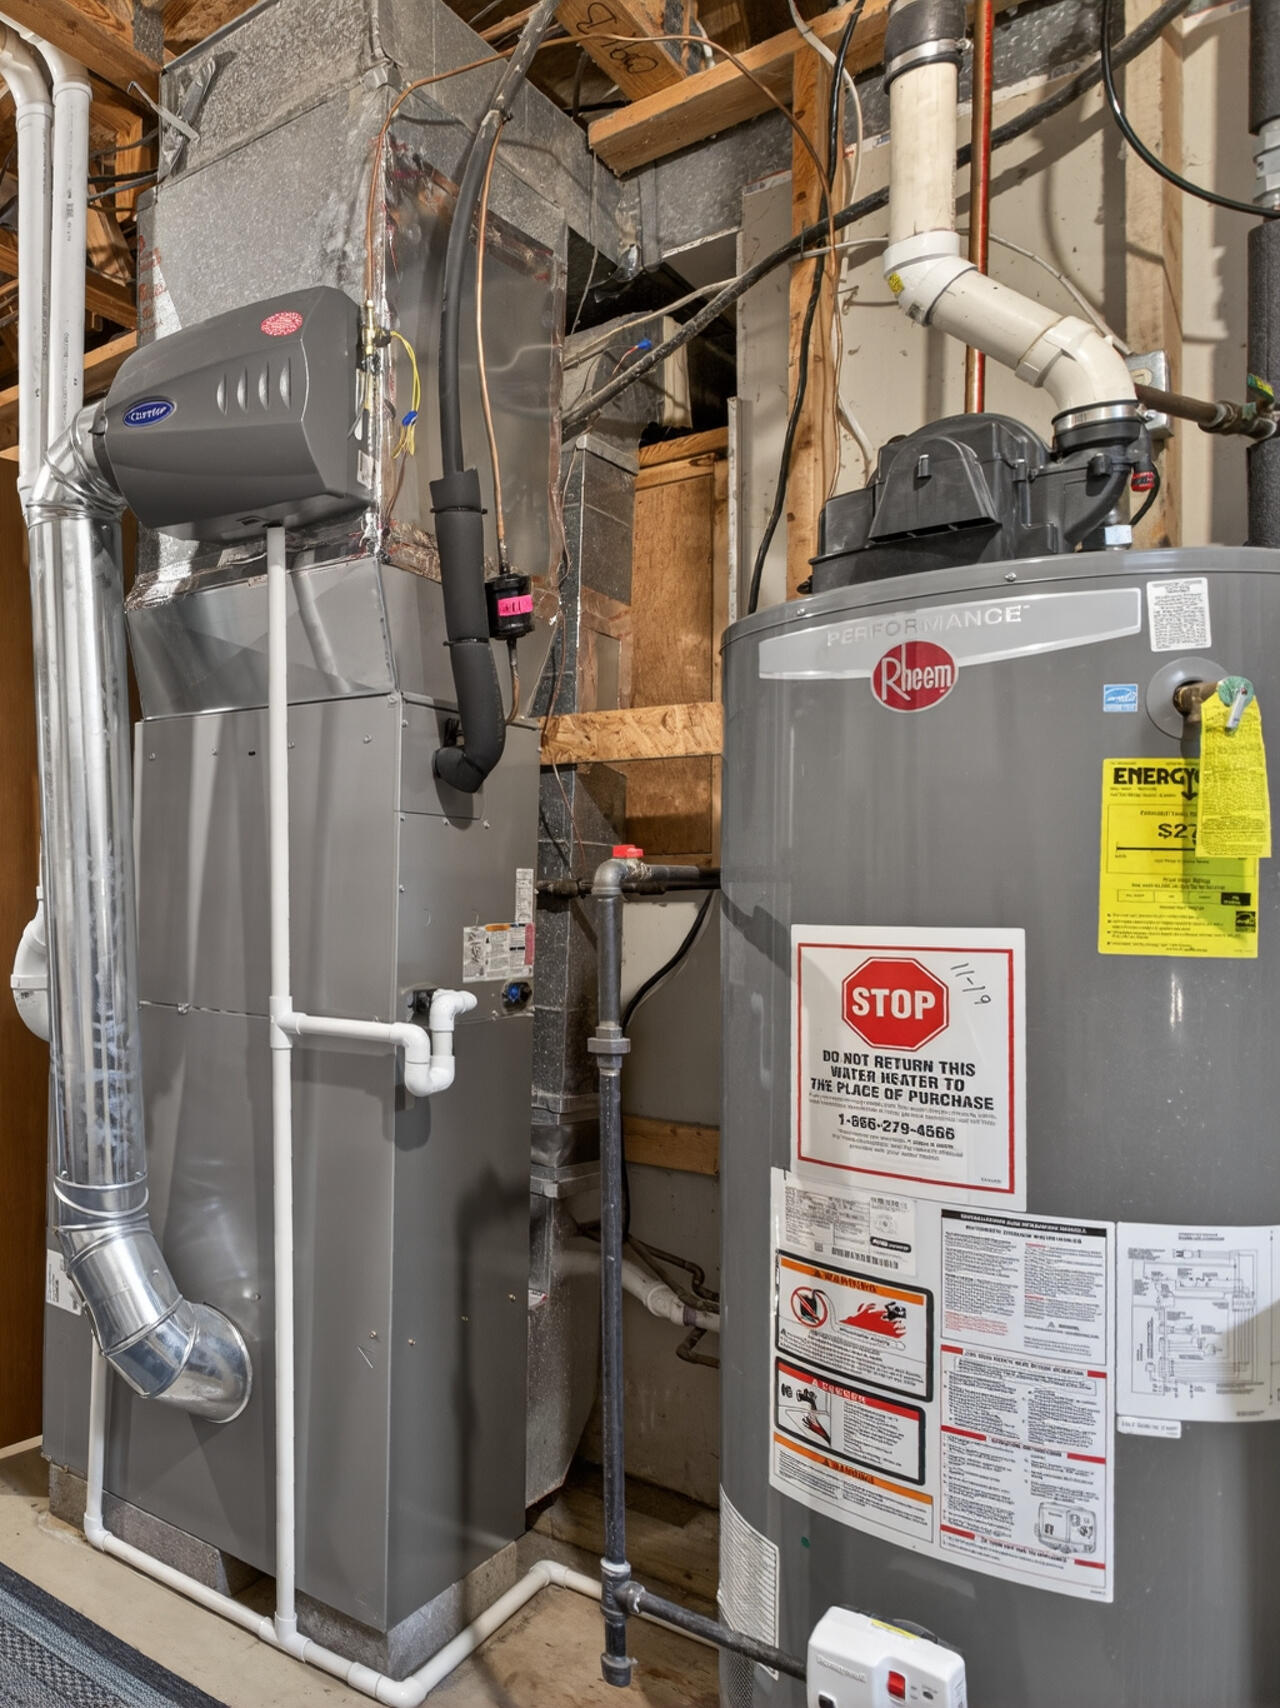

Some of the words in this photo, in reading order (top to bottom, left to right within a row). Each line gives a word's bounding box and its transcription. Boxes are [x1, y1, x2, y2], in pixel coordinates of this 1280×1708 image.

[827, 605, 1023, 647] PERFORMANCE
[881, 643, 952, 701] Rheem
[1113, 767, 1199, 785] ENERGY
[852, 986, 936, 1020] STOP
[823, 1049, 840, 1064] DO
[844, 1052, 869, 1067] NOT
[875, 1054, 933, 1074] RETURN
[939, 1060, 976, 1077] THIS
[830, 1065, 876, 1083] WATER
[881, 1070, 938, 1090] HEATER
[944, 1077, 965, 1092] TO
[810, 1077, 833, 1093] THE
[837, 1081, 879, 1099] PLACE
[884, 1087, 903, 1101] OF
[909, 1090, 995, 1111] PURCHASE
